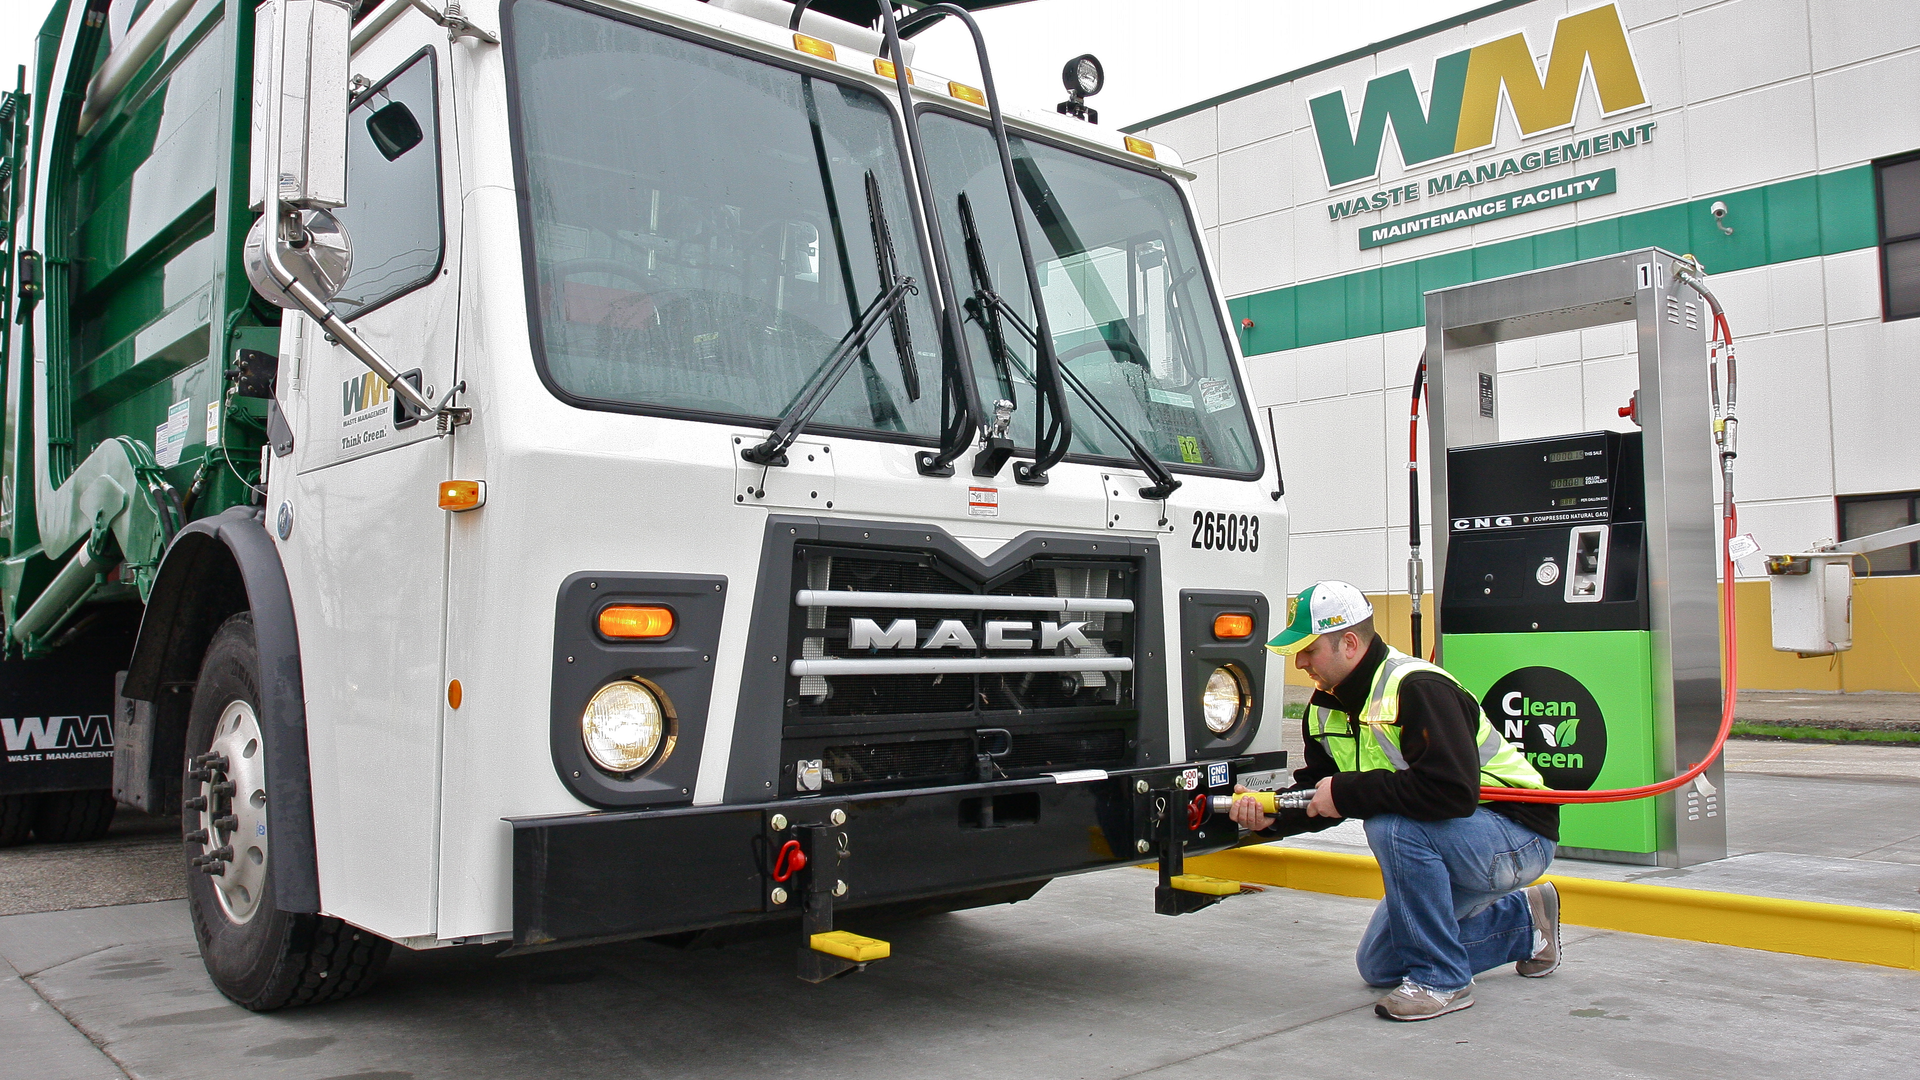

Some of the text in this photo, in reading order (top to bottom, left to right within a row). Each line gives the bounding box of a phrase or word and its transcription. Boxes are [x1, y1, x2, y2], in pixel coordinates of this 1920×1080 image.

[1308, 2, 1648, 189] WM
[1327, 121, 1656, 220] WASTE MANAGEMENT
[1372, 177, 1600, 241] MAINTENANCE FACILITY
[1640, 265, 1649, 287] 1
[343, 370, 389, 417] WM
[343, 407, 389, 428] WASTE MANAGEMENT
[342, 433, 361, 449] Think
[1182, 441, 1197, 455] 12
[1532, 513, 1570, 523] (COMPRESSED
[1570, 511, 1595, 520] NATURAL
[1191, 510, 1259, 552] 265033
[1318, 615, 1344, 628] WM
[848, 617, 1094, 649] MACK
[1502, 691, 1577, 716] Clean
[0, 715, 114, 751] WM
[8, 751, 114, 762] WASTE MANAGEMENT
[1210, 765, 1226, 776] CNG
[1211, 775, 1226, 785] FILL
[1244, 776, 1273, 788] Illinois
